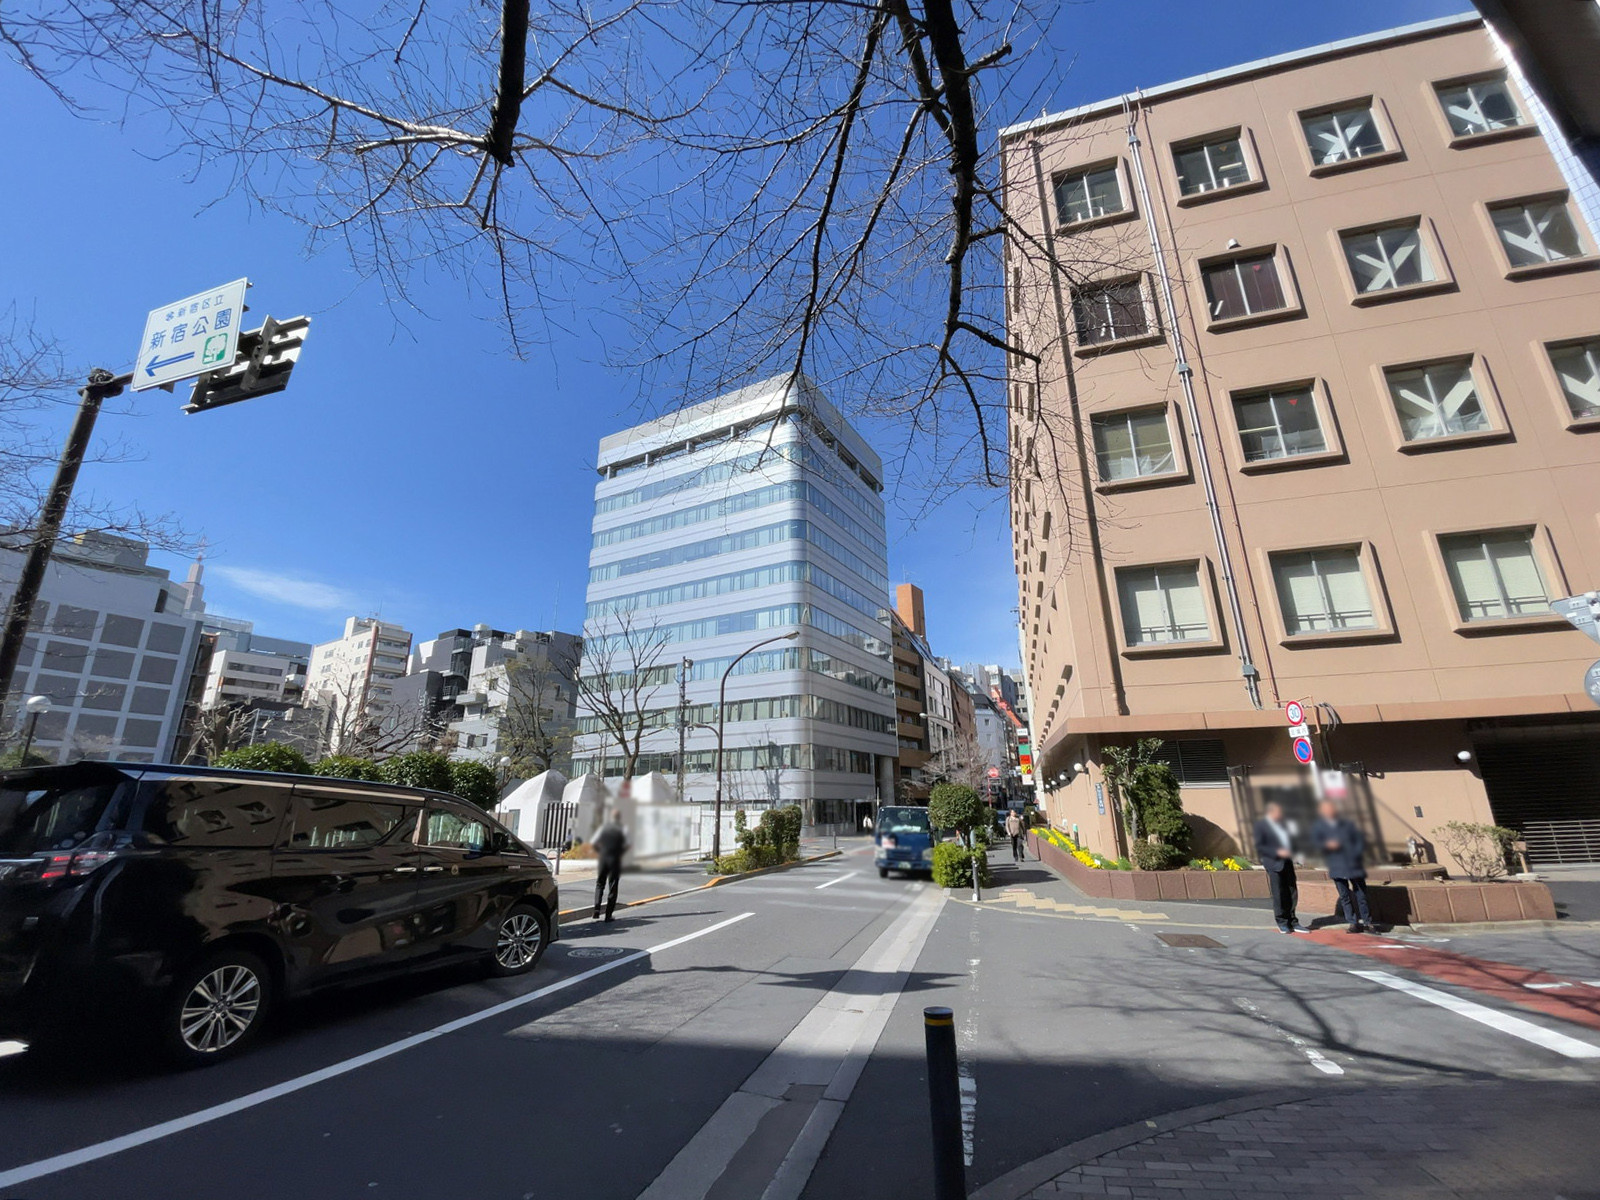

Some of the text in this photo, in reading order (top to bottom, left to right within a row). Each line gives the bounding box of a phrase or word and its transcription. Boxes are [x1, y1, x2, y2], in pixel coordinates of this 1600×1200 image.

[150, 308, 232, 350] 新宿公園
[1289, 707, 1300, 719] 30
